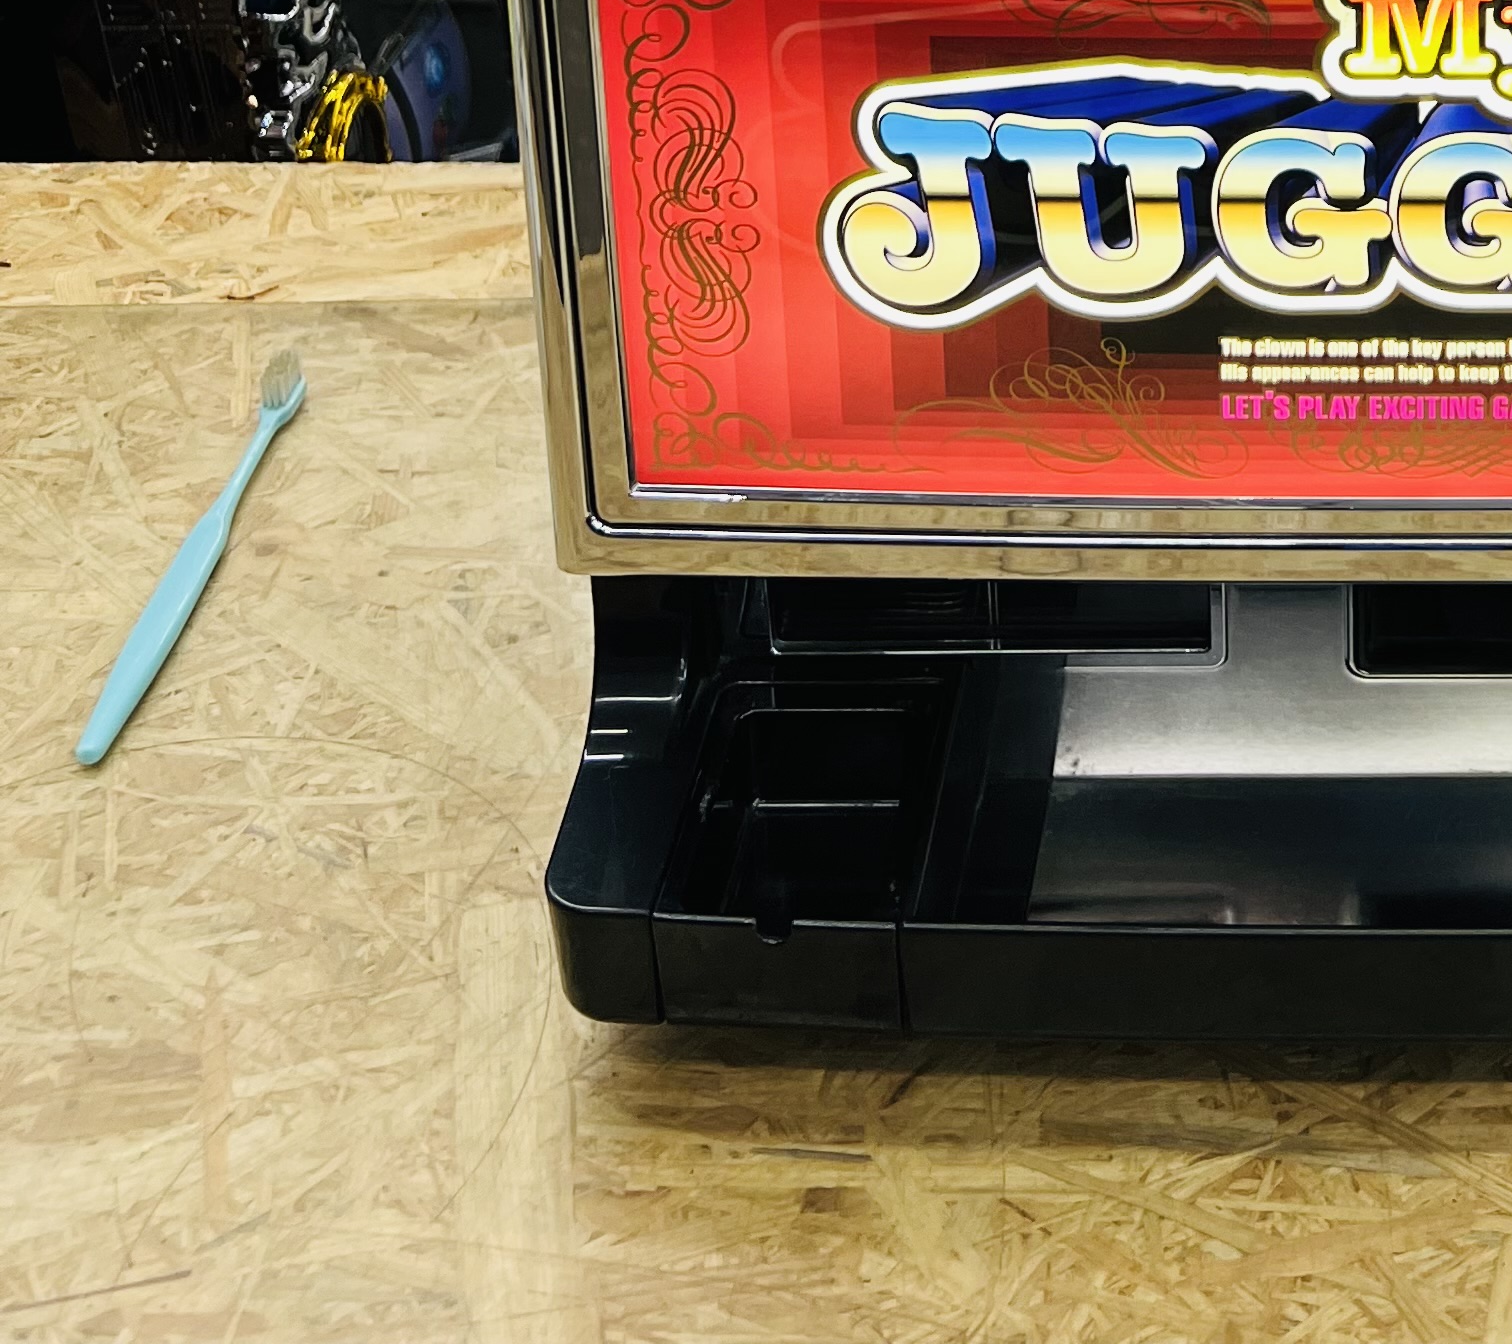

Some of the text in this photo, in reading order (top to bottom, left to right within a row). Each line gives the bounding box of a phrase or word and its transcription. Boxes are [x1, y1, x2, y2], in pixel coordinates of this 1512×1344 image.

[1220, 338, 1252, 357] The
[1254, 338, 1307, 357] clown
[1308, 338, 1326, 357] is
[1327, 338, 1358, 357] one
[1361, 338, 1380, 357] of
[1381, 338, 1409, 357] the
[1410, 338, 1444, 360] key
[1445, 338, 1506, 360] person
[1219, 363, 1249, 382] His
[1251, 363, 1361, 384] appearances
[1363, 363, 1395, 382] can
[1397, 363, 1434, 384] help
[1437, 363, 1456, 382] to
[1457, 363, 1500, 384] keep
[1221, 389, 1291, 421] LET'S
[1299, 394, 1361, 421] PLAY
[1369, 394, 1485, 421] EXCITING
